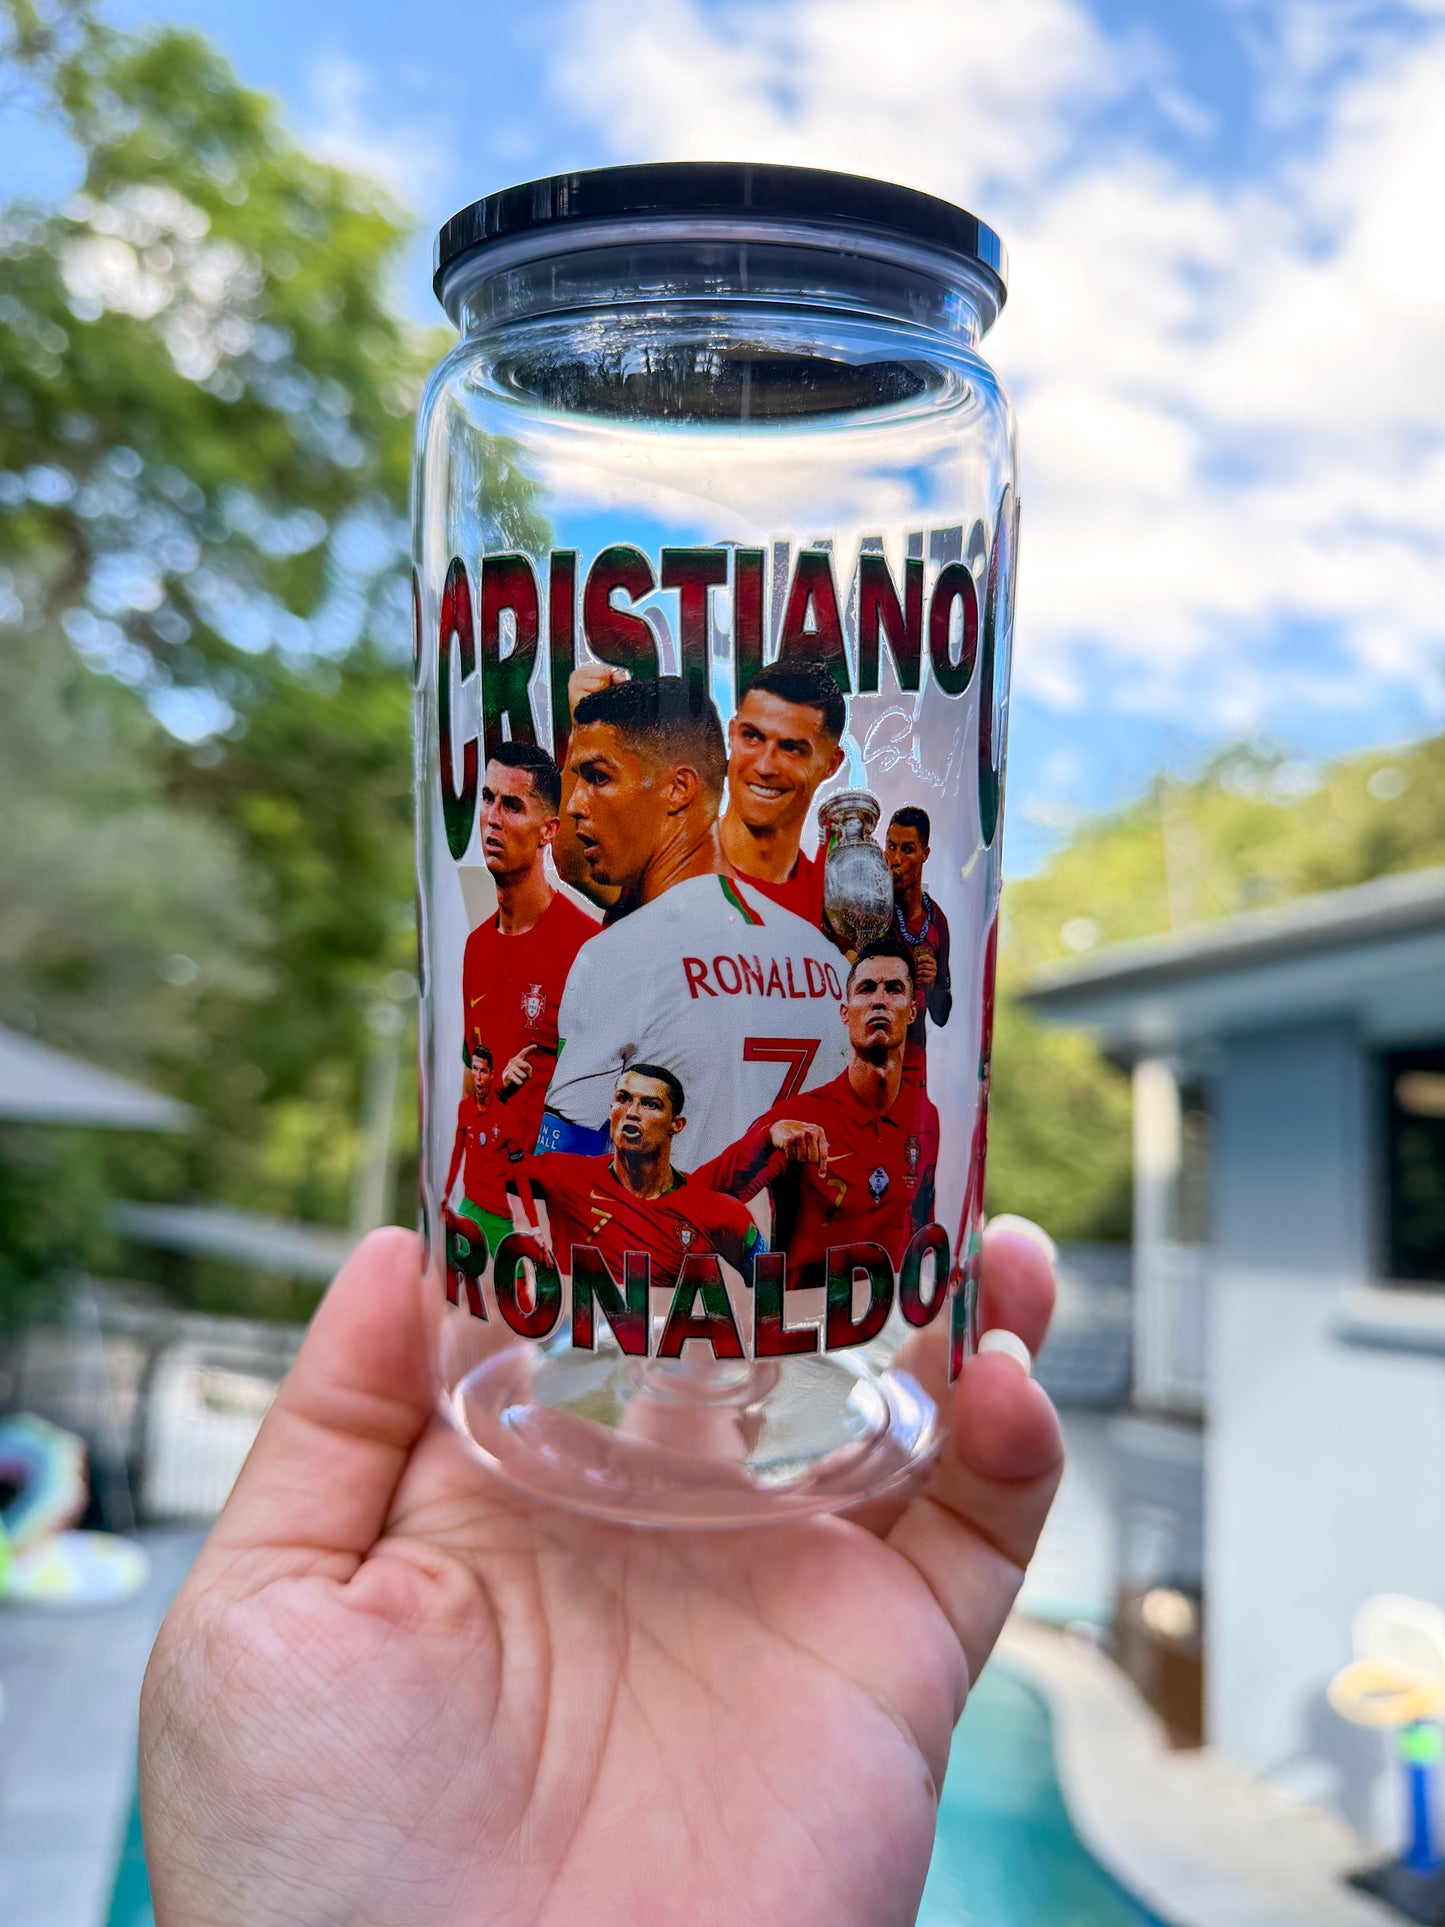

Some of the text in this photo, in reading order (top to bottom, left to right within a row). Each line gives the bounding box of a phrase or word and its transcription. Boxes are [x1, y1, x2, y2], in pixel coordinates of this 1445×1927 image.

[437, 542, 980, 861] CRISTIANO
[682, 953, 843, 1001] RONALDO
[743, 1037, 822, 1108] 7
[590, 1206, 613, 1243] 7
[445, 1211, 950, 1360] RONALDO
